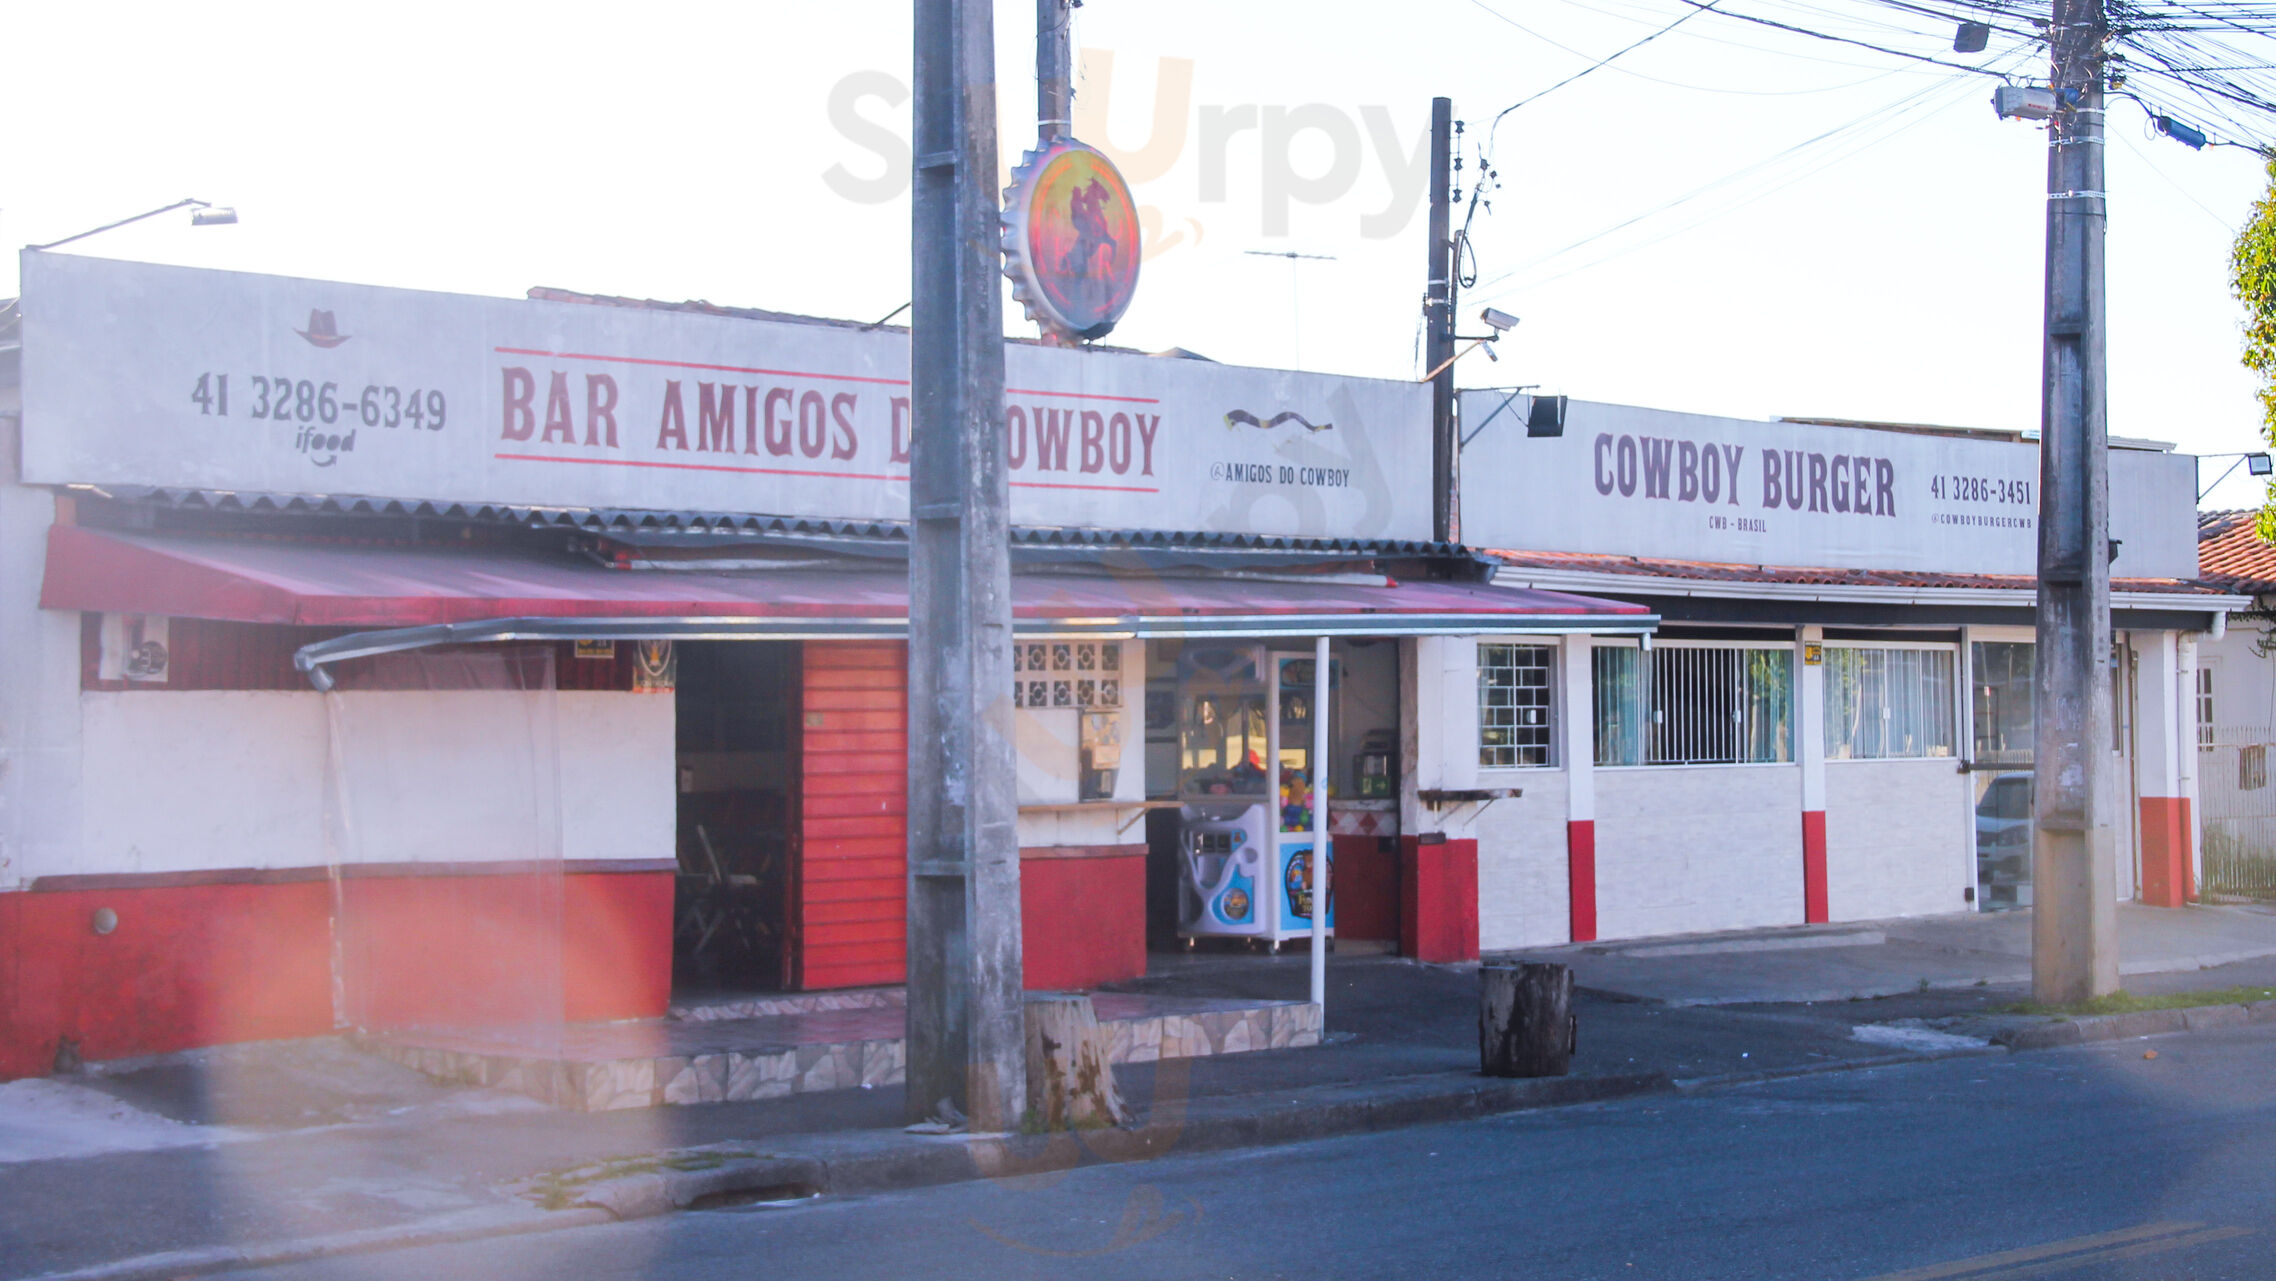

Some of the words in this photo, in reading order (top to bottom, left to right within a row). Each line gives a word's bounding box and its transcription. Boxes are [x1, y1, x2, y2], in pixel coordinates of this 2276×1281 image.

[191, 371, 229, 417] 41
[251, 375, 447, 431] 3286-6349
[500, 366, 620, 449] BAR
[656, 379, 858, 461] AMIGOS
[889, 395, 910, 464] D
[1006, 404, 1161, 477] OWBOY
[1210, 461, 1272, 484] @AMIGOS
[1280, 466, 1295, 485] DO
[1300, 467, 1350, 488] COWBOY
[1594, 432, 1744, 506] COWBOY
[1762, 448, 1896, 518] BURGER
[1931, 474, 1946, 500] 41
[1952, 475, 2031, 505] 3286-3451
[1709, 515, 1727, 530] CWB
[1737, 517, 1767, 533] BRASIL
